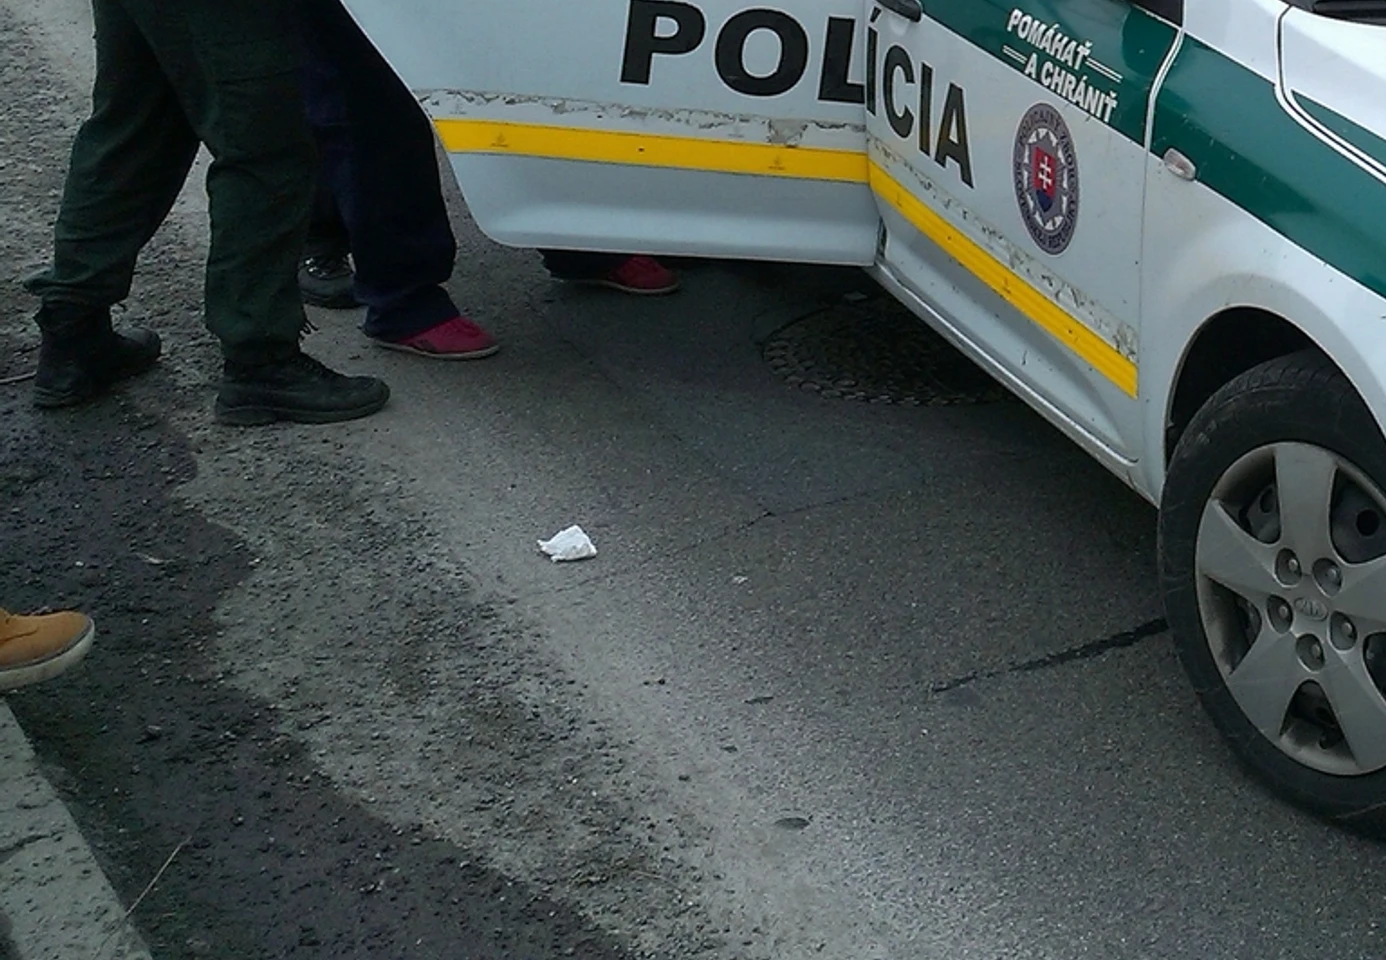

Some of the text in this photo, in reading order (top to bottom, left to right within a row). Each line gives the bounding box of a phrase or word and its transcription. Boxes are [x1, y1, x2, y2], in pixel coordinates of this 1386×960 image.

[1006, 8, 1093, 71] POMÁHAŤ
[1024, 52, 1118, 123] A CHRÁNIŤ
